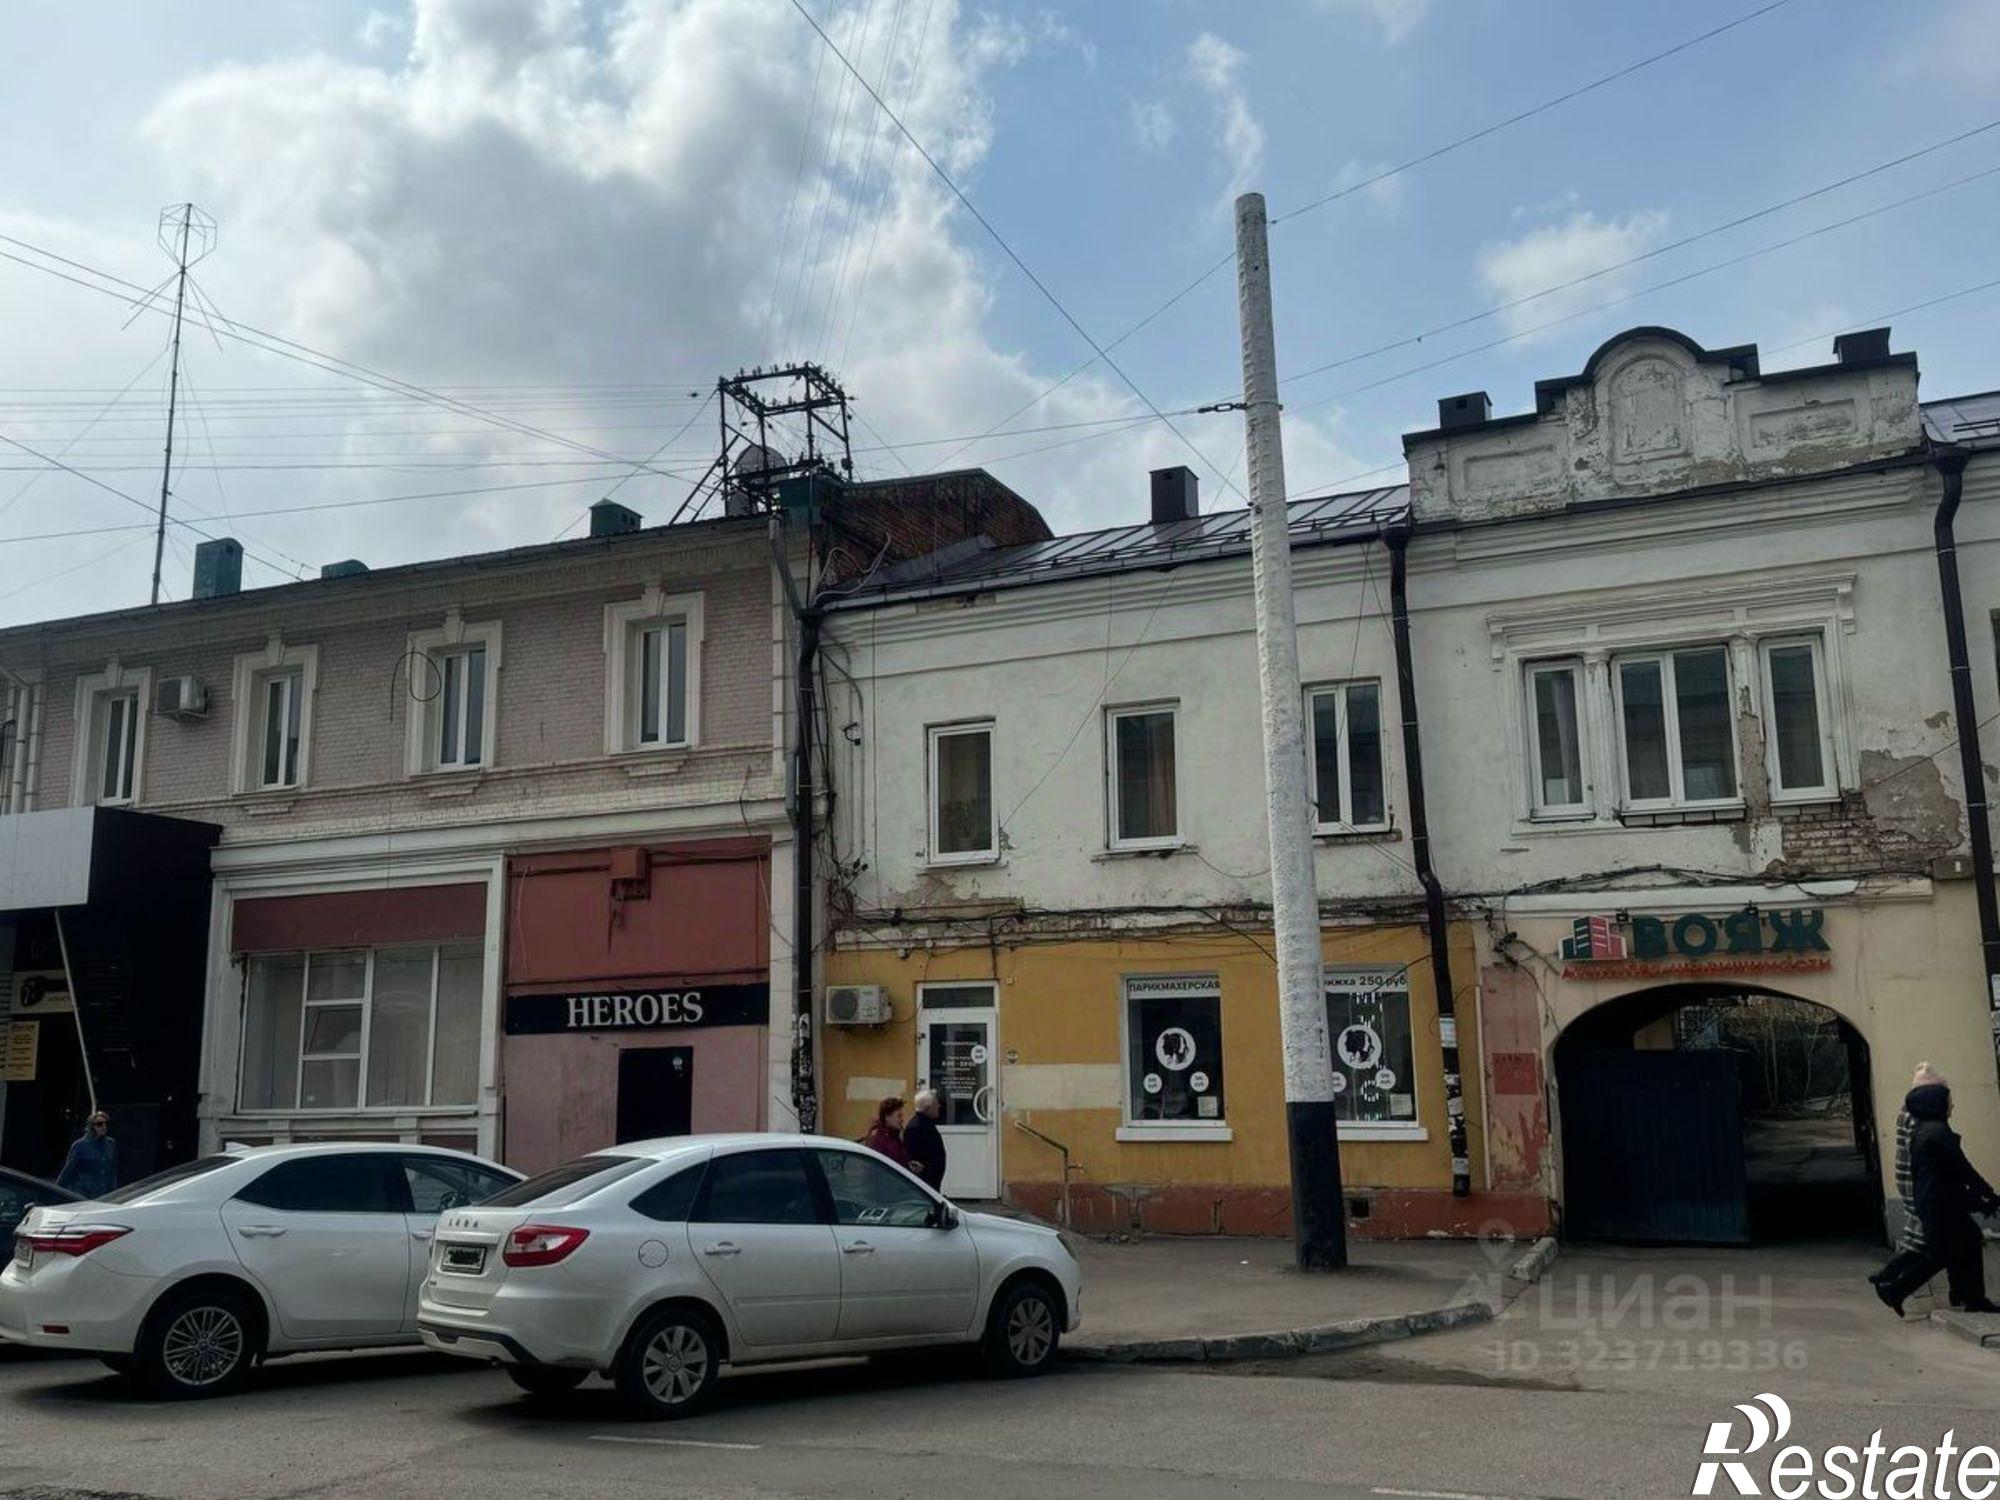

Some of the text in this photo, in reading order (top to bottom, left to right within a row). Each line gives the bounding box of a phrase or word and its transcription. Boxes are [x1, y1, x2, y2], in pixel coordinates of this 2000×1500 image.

[1632, 907, 1831, 959] ВОЯЖ
[1129, 980, 1220, 992] ПАРИКМАХЕРСКАЯ
[1324, 974, 1406, 988] ижка 250 руб
[566, 991, 704, 1028] HEROES
